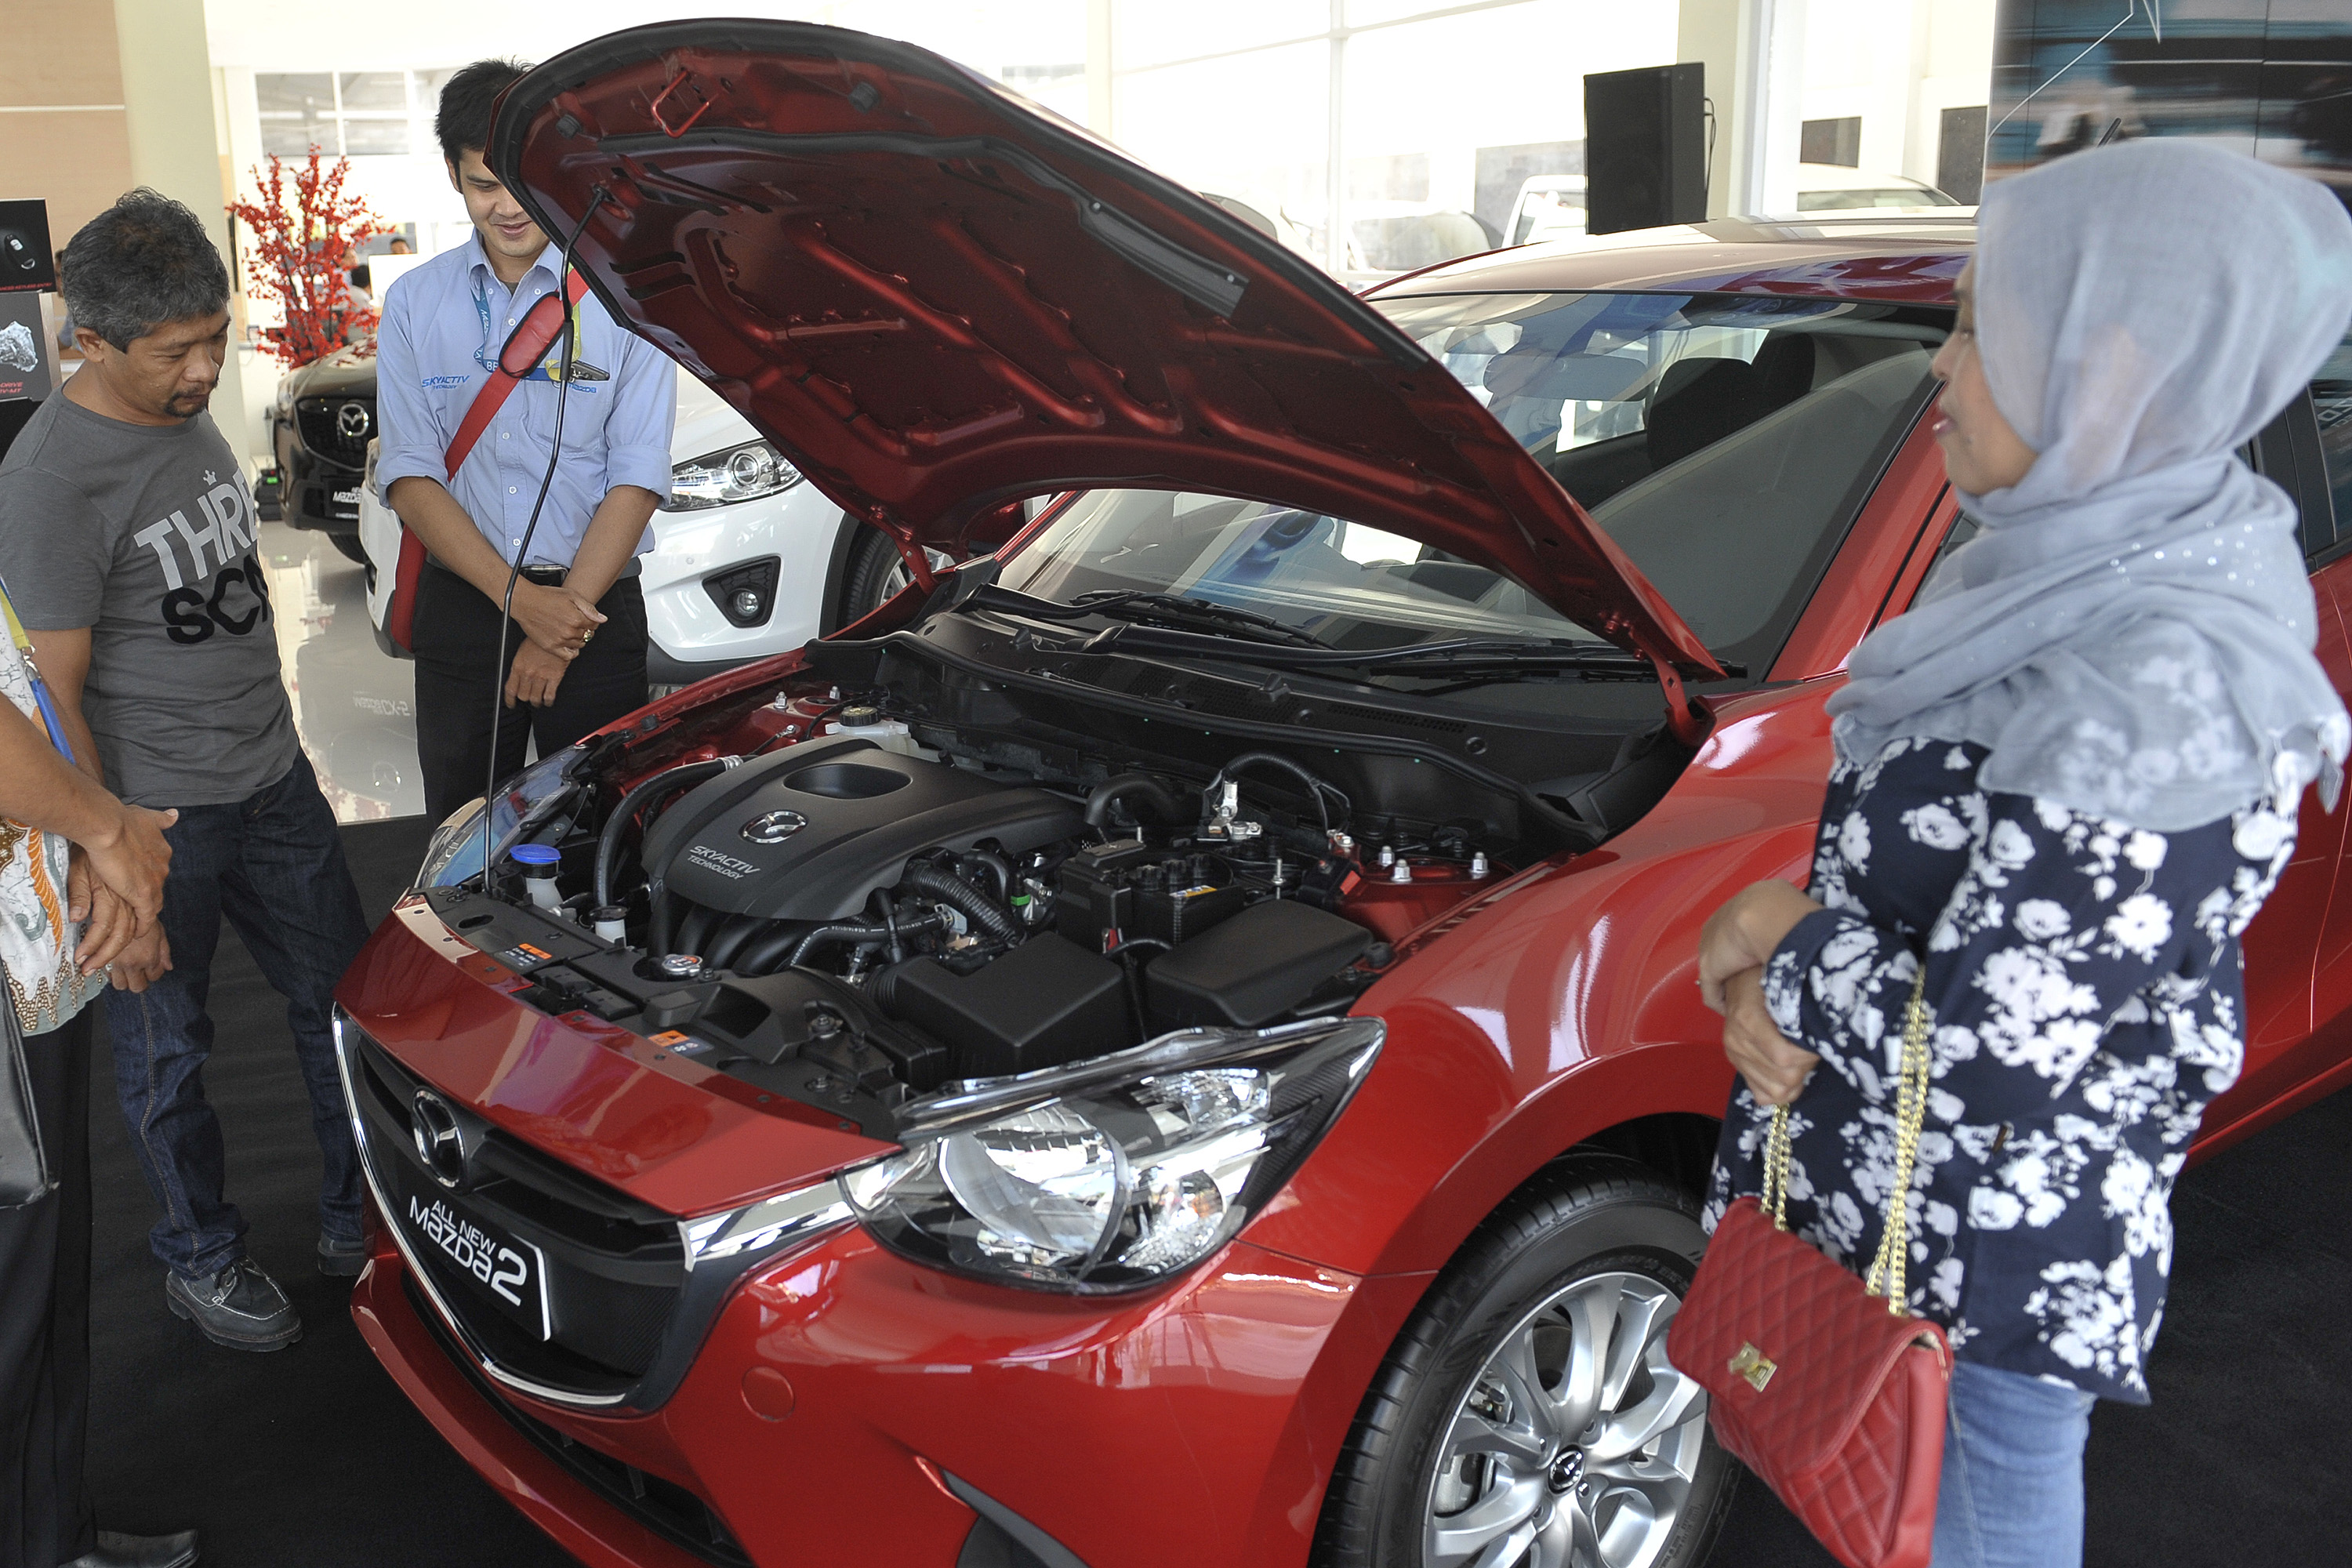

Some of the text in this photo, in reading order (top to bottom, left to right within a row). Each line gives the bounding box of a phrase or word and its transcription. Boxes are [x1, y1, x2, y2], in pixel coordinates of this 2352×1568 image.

[421, 376, 470, 387] SKYACTIV
[688, 855, 744, 880] TECHNOLOGY
[690, 845, 760, 874] SKYACTIV
[431, 1200, 496, 1255] ALL NEW
